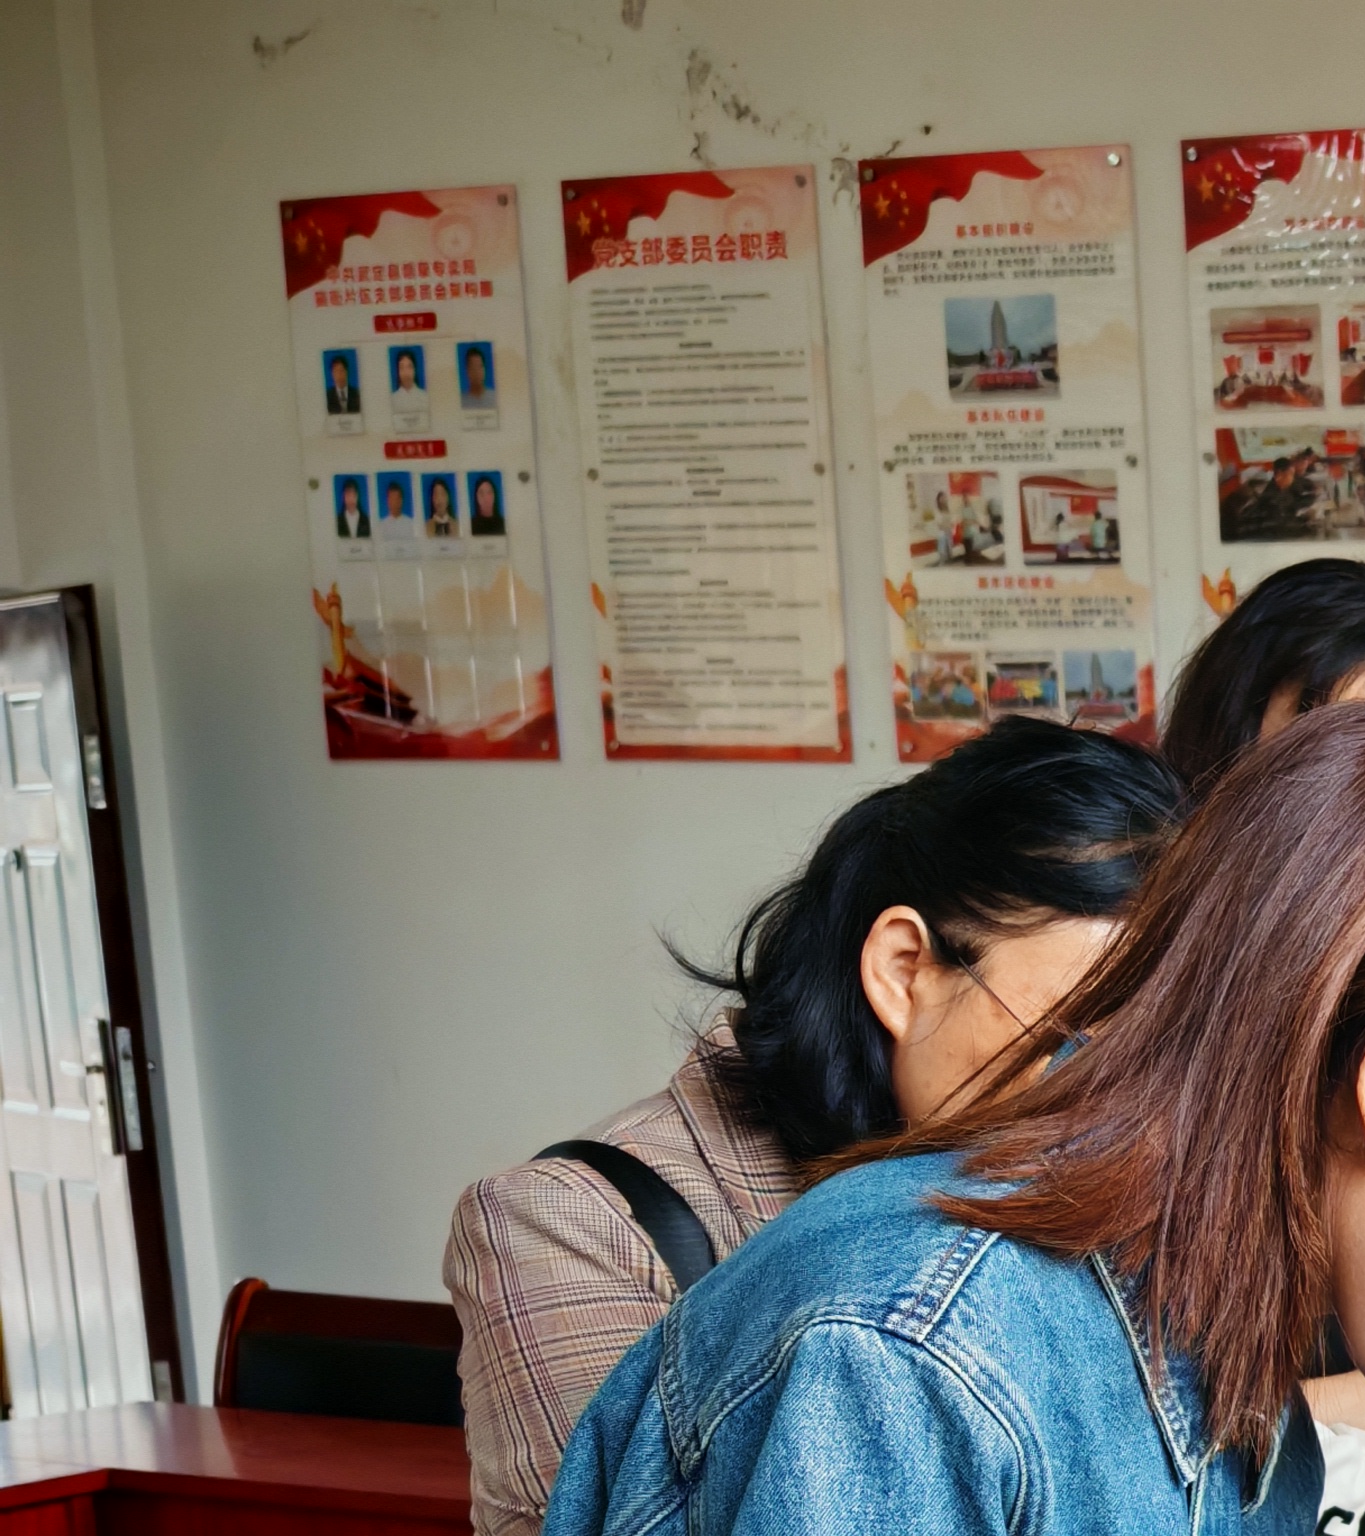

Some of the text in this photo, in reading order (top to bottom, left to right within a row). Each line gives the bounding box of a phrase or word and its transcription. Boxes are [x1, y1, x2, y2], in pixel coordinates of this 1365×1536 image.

[591, 230, 788, 268] 党支部委员会职责
